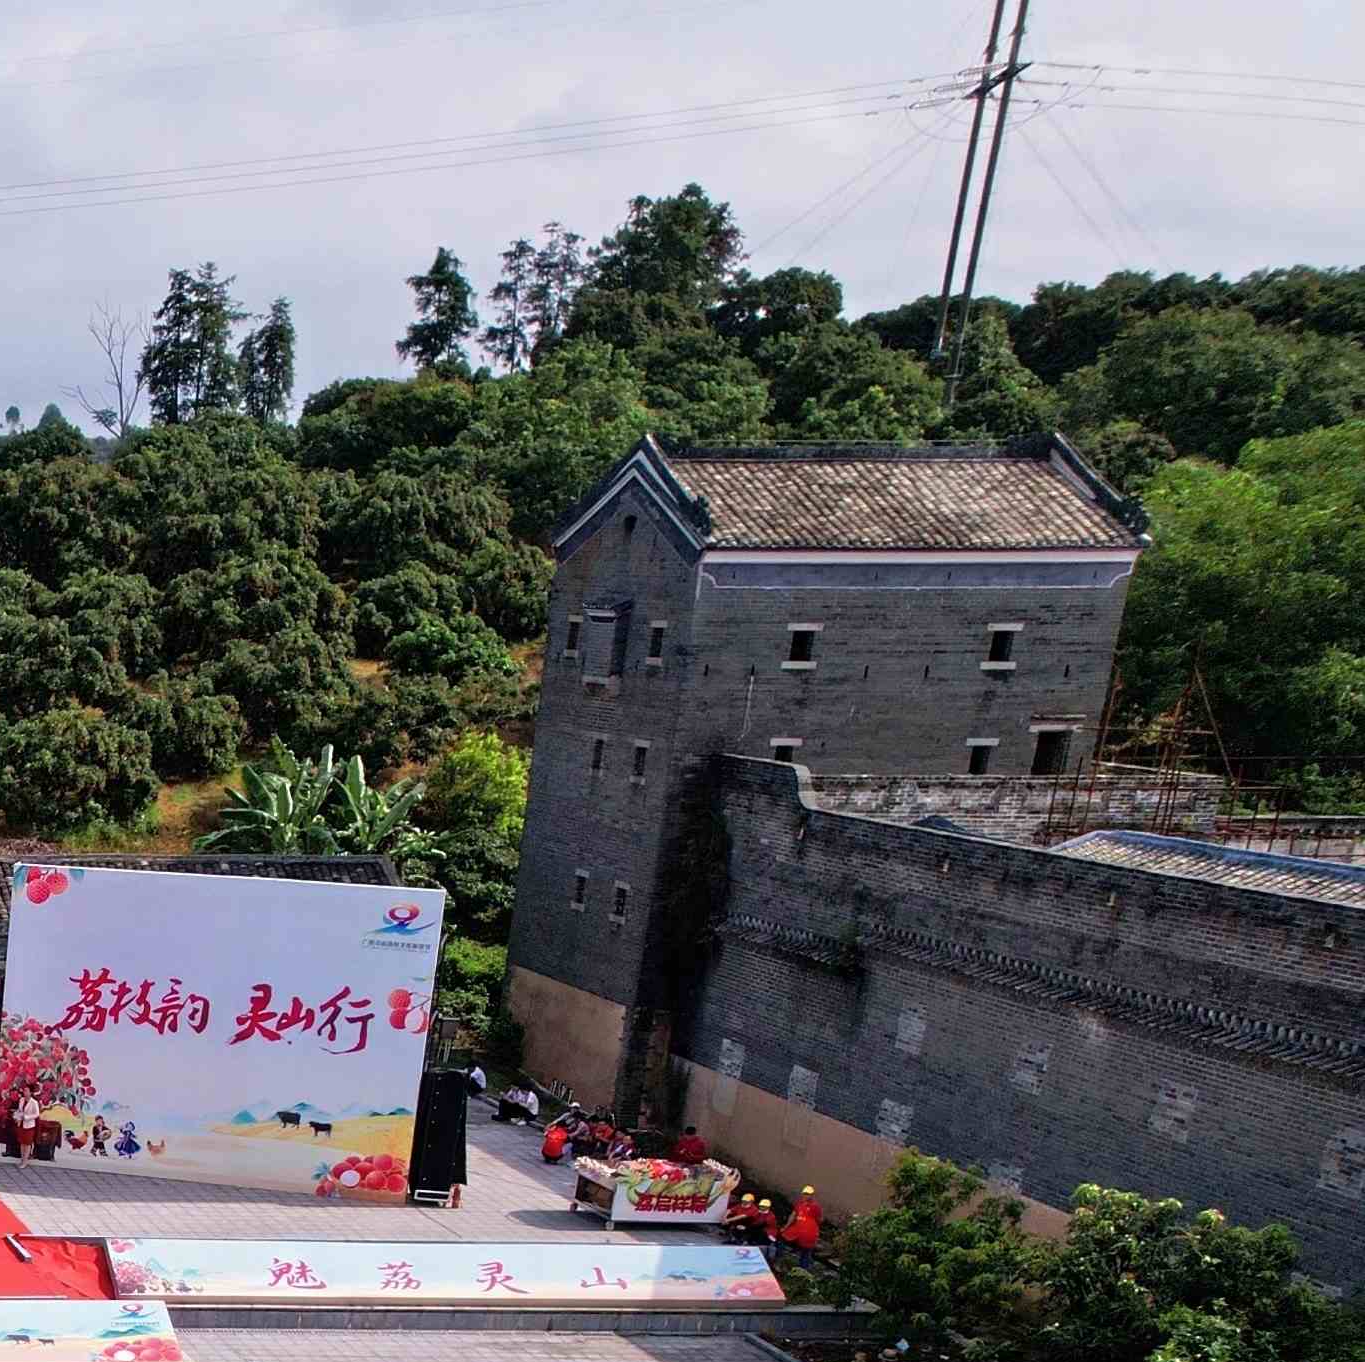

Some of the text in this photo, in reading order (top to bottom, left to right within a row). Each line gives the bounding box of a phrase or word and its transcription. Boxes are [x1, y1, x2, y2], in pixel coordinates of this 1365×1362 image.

[51, 967, 376, 1055] 荔枝韵 灵山行
